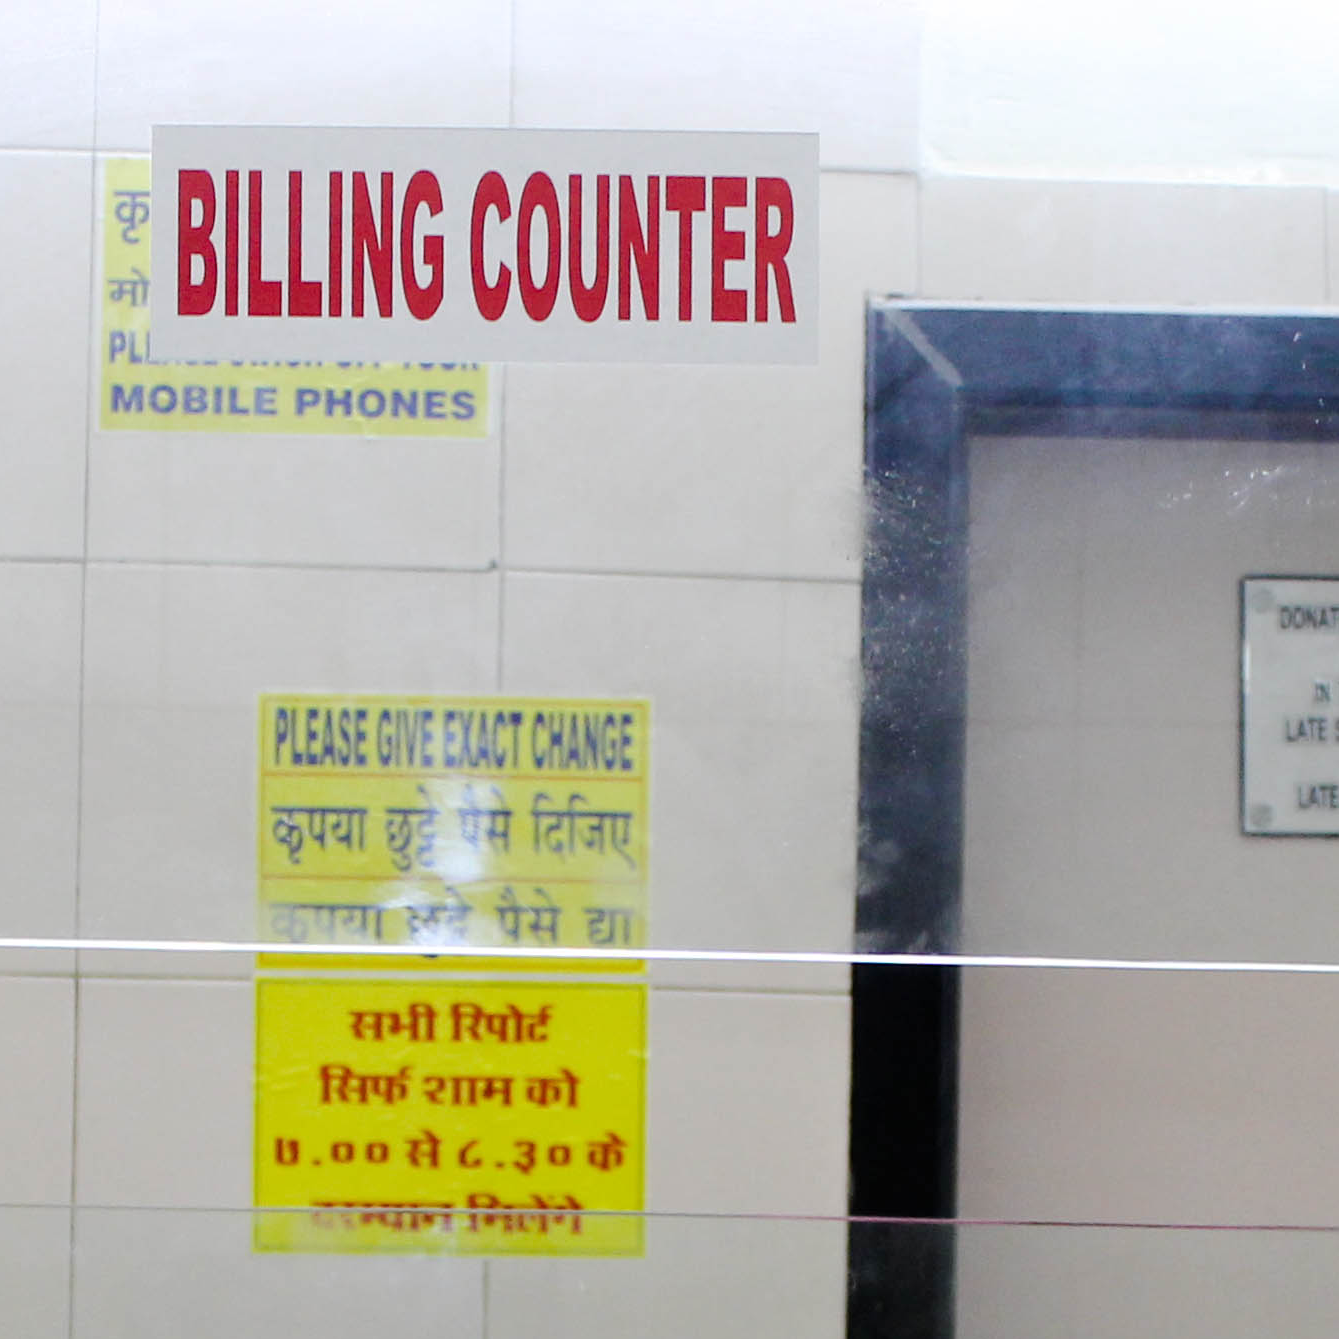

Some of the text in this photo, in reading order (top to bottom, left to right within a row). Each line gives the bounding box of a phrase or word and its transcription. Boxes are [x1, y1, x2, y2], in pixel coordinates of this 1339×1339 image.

[177, 169, 797, 323] BILLING COUNTER
[111, 384, 475, 420] MOBILE PHONES
[1314, 681, 1330, 704] IN
[275, 708, 634, 772] PLEASE GIVE EXACT CHANGE
[1286, 718, 1327, 743] LATE
[1298, 785, 1339, 809] LATE
[272, 807, 367, 864] कृपया
[532, 793, 637, 869] दिजिए
[496, 887, 561, 944] पैसे
[350, 1003, 552, 1044] सभी रिपोर्ट
[320, 1064, 580, 1108] सिर्फ शाम को
[405, 1130, 442, 1170] से
[587, 1132, 627, 1174] के
